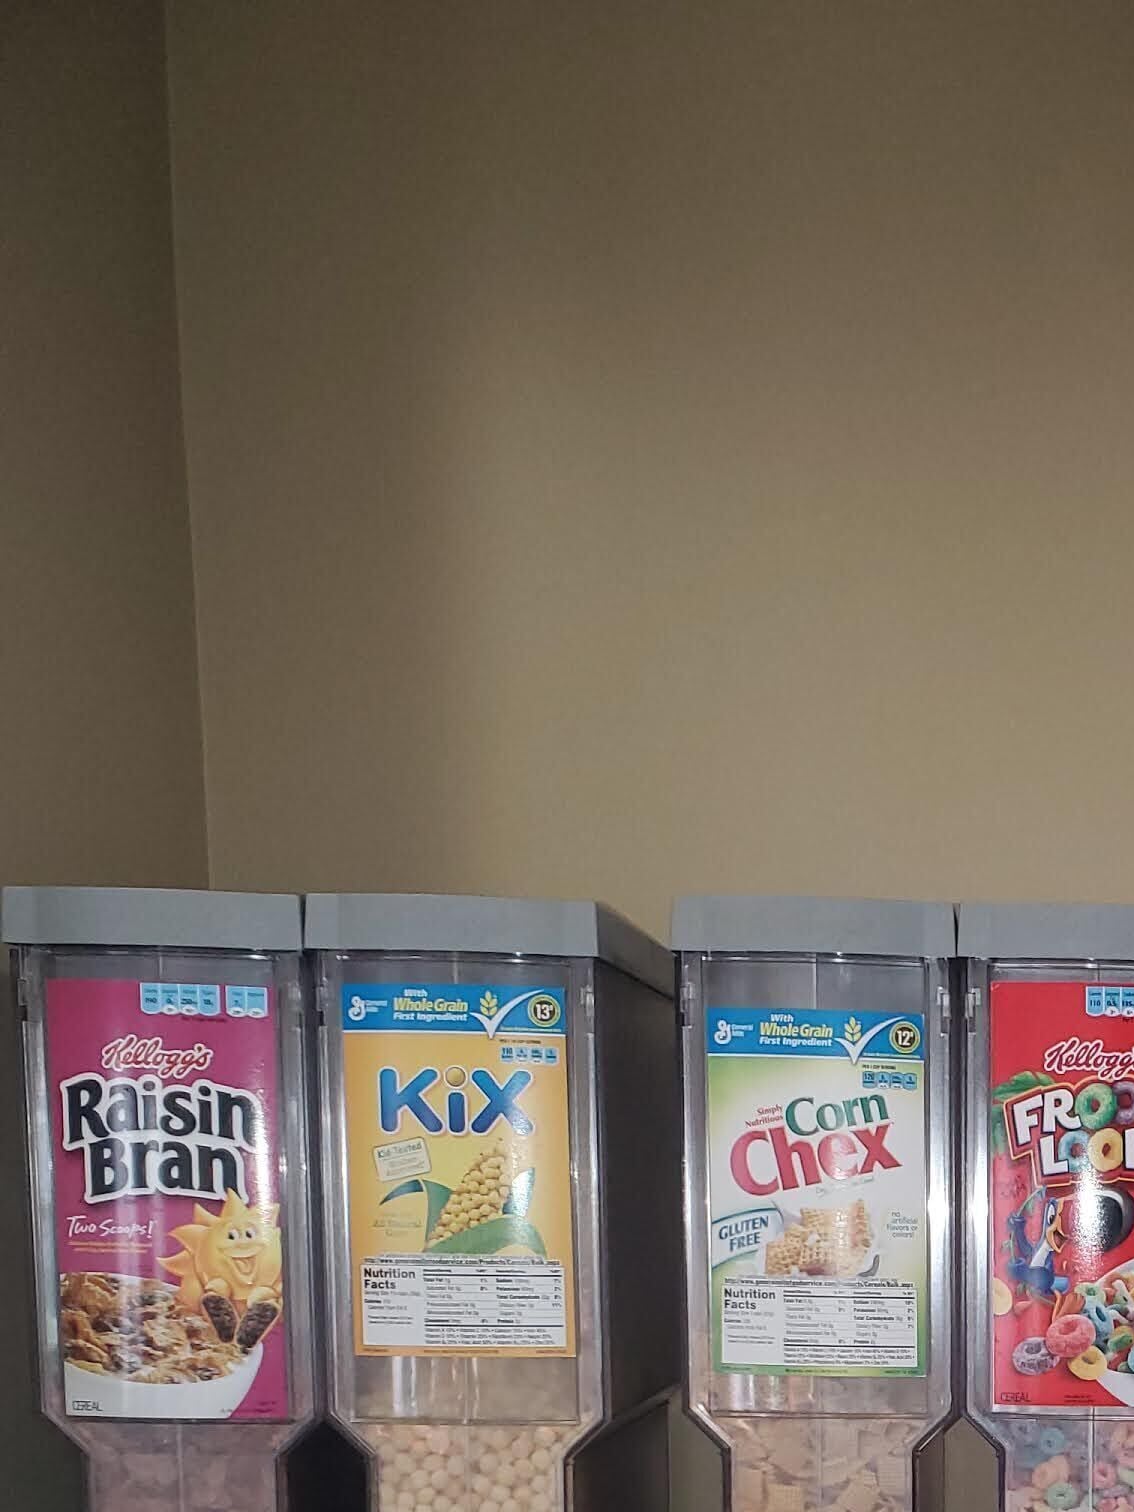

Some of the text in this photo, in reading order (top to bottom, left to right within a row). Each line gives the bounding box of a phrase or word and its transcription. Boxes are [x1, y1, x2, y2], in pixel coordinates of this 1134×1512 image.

[404, 989, 428, 997] With
[393, 998, 468, 1012] Whole Grain
[393, 1011, 468, 1023] First Ingredient
[770, 1014, 794, 1023] With
[759, 1022, 833, 1038] Whole Grain
[759, 1037, 833, 1047] First Ingredient
[102, 1034, 213, 1079] Kellogg's
[64, 1074, 260, 1147] Raisin
[757, 1104, 784, 1115] Simply
[785, 1094, 890, 1136] Corn
[744, 1114, 784, 1128] Nutritious
[730, 1124, 903, 1196] Chex
[87, 1138, 240, 1198] Bran
[66, 1215, 154, 1239] Two Scoops!
[719, 1215, 769, 1240] GLUTEN
[729, 1232, 761, 1252] FREE
[364, 1268, 416, 1279] Nutrition
[364, 1280, 396, 1289] Facts
[724, 1288, 776, 1300] Nutrition
[724, 1300, 757, 1310] Facts
[1000, 1391, 1029, 1402] CEREAL
[72, 1400, 103, 1412] CEREAL
